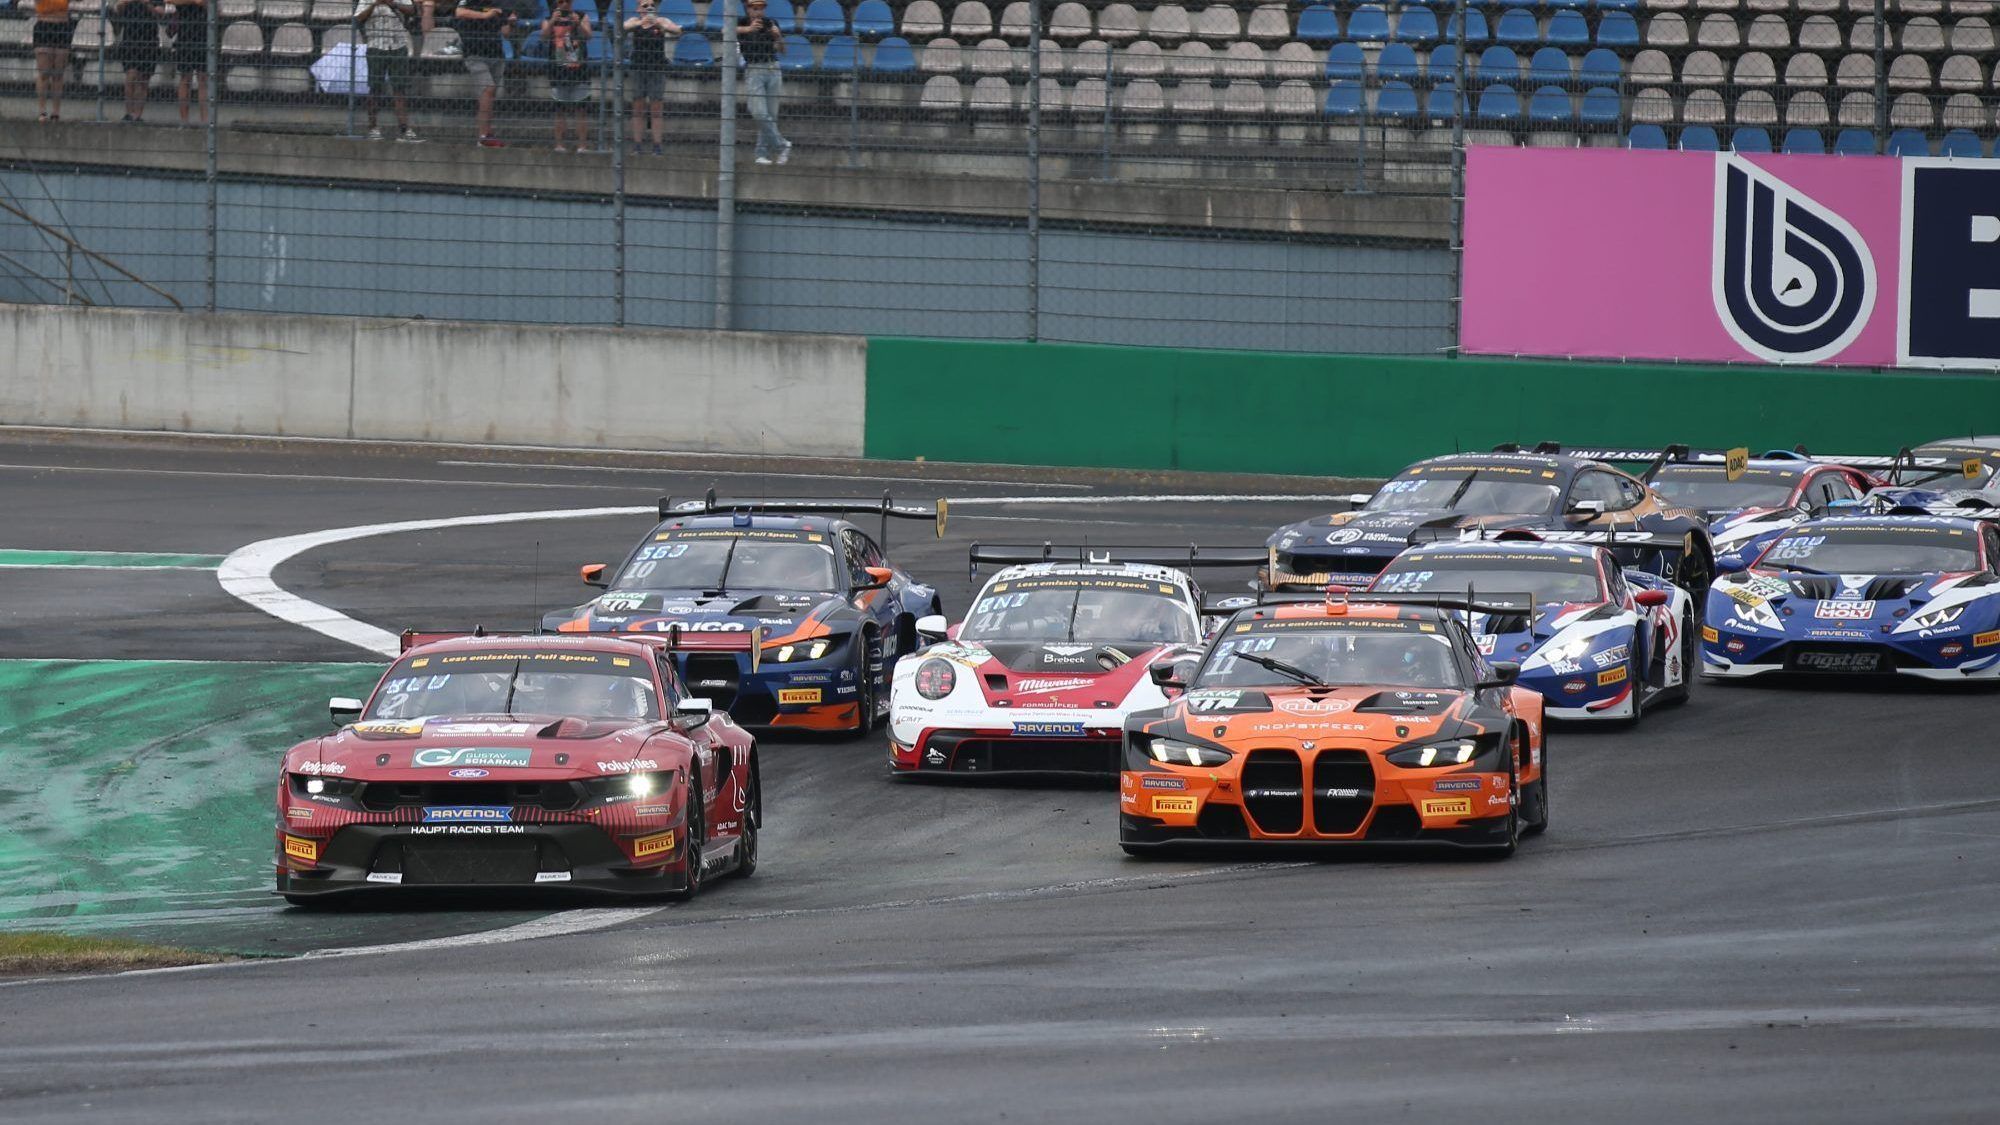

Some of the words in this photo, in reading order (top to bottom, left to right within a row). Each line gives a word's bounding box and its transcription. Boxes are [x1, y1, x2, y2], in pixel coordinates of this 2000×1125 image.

[1729, 457, 1745, 473] ADAC
[623, 561, 658, 580] 10
[1095, 579, 1116, 587] Full
[1116, 581, 1150, 590] Speed.
[1821, 600, 1872, 610] LIQUI
[1820, 609, 1870, 618] MOLY
[1372, 621, 1408, 629] Speed.
[469, 653, 532, 661] emissions.
[560, 654, 599, 663] Speed.
[1043, 653, 1086, 663] Brebeck
[1205, 655, 1239, 675] 11
[1015, 677, 1096, 691] Milwaukee
[376, 692, 409, 716] 2
[1018, 723, 1079, 733] RAVENOL
[465, 758, 527, 766] SCHARNAU
[596, 758, 658, 773] Polyvlies
[299, 760, 347, 775] Polyvlies
[1145, 780, 1182, 788] RAVENOL
[1438, 781, 1478, 789] RAVENOL
[1156, 799, 1193, 810] PIRELLI
[1426, 801, 1467, 813] PIRELLI
[431, 809, 505, 818] RAVENOL
[411, 825, 448, 834] HAUPT
[449, 825, 492, 833] RACING
[493, 824, 525, 833] TEAM
[717, 822, 727, 831] ADAC
[287, 840, 314, 856] PIRELLI
[639, 834, 673, 852] PIRELLI
